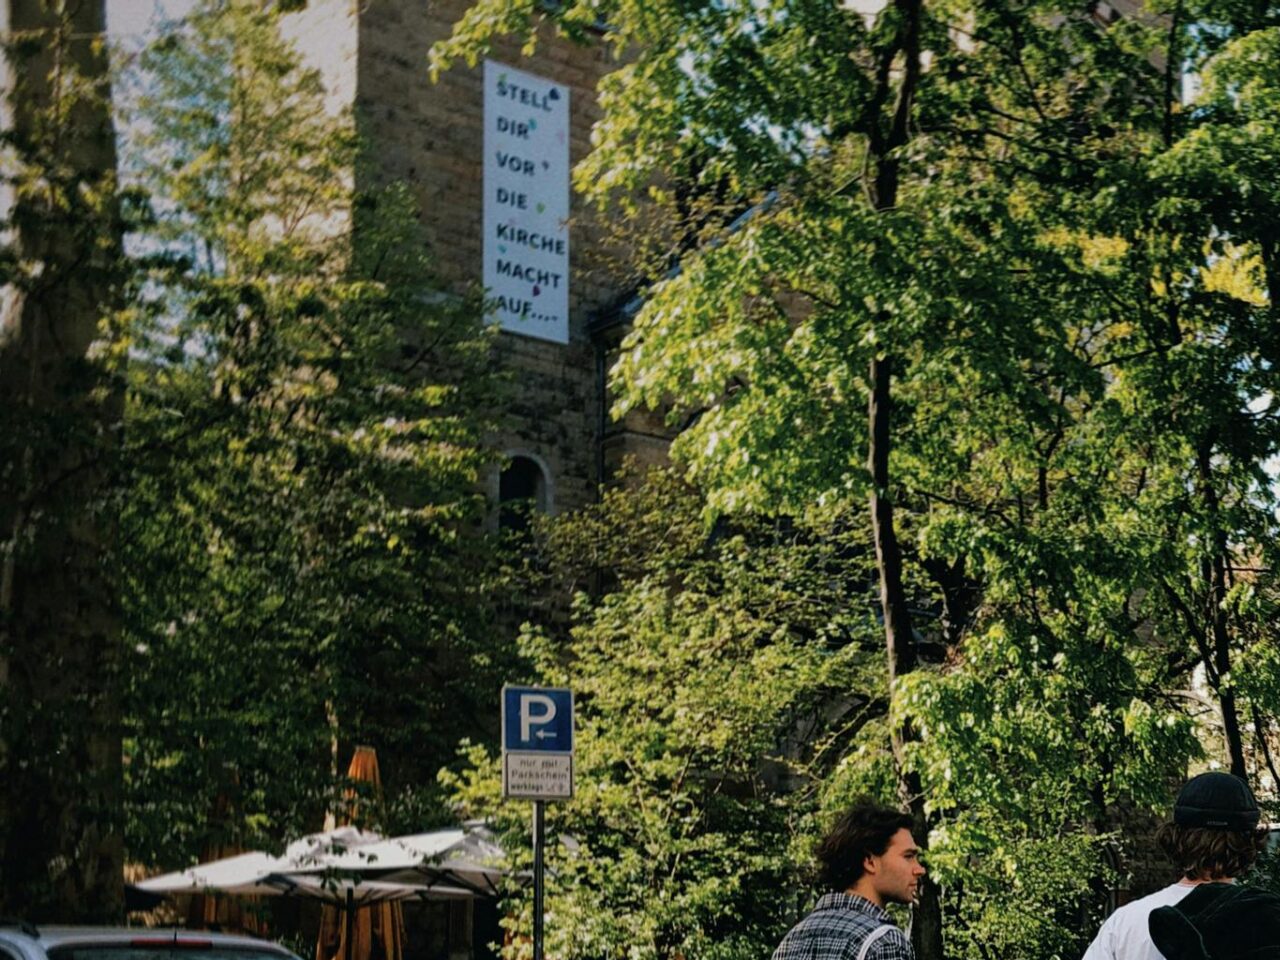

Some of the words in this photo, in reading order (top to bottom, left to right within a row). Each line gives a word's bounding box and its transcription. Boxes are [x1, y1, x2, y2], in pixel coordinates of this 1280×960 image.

[496, 82, 552, 111] STELL
[496, 117, 529, 139] DIR
[496, 152, 535, 176] VOR
[496, 188, 528, 210] DIE
[496, 223, 566, 255] KIRCHE
[496, 260, 561, 289] MACHT
[520, 694, 557, 742] P
